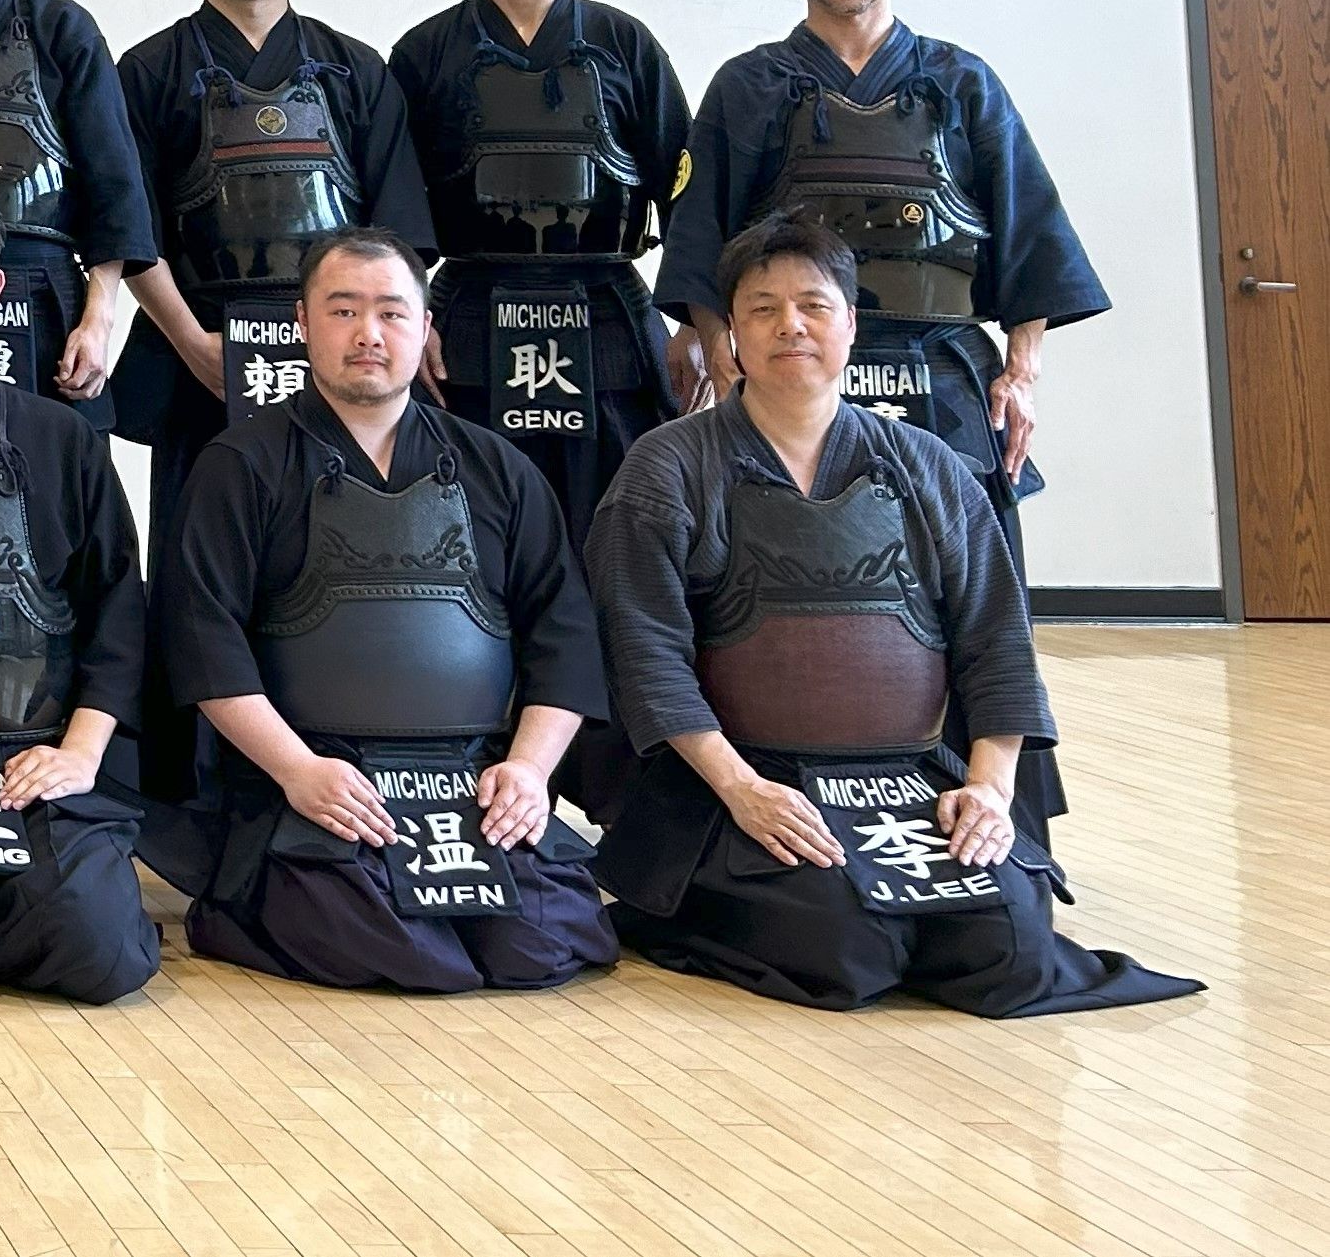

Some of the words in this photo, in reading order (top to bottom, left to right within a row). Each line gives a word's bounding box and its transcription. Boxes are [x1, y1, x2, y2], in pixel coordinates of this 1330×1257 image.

[498, 303, 589, 329] MICHIGAN
[230, 319, 306, 345] MICHIGA
[506, 338, 582, 400] 耿
[840, 364, 932, 396] ICHIGAN
[502, 409, 584, 430] GENG
[816, 772, 939, 808] MICHGAN
[853, 811, 952, 880] 李
[870, 872, 1001, 902] J.LEE
